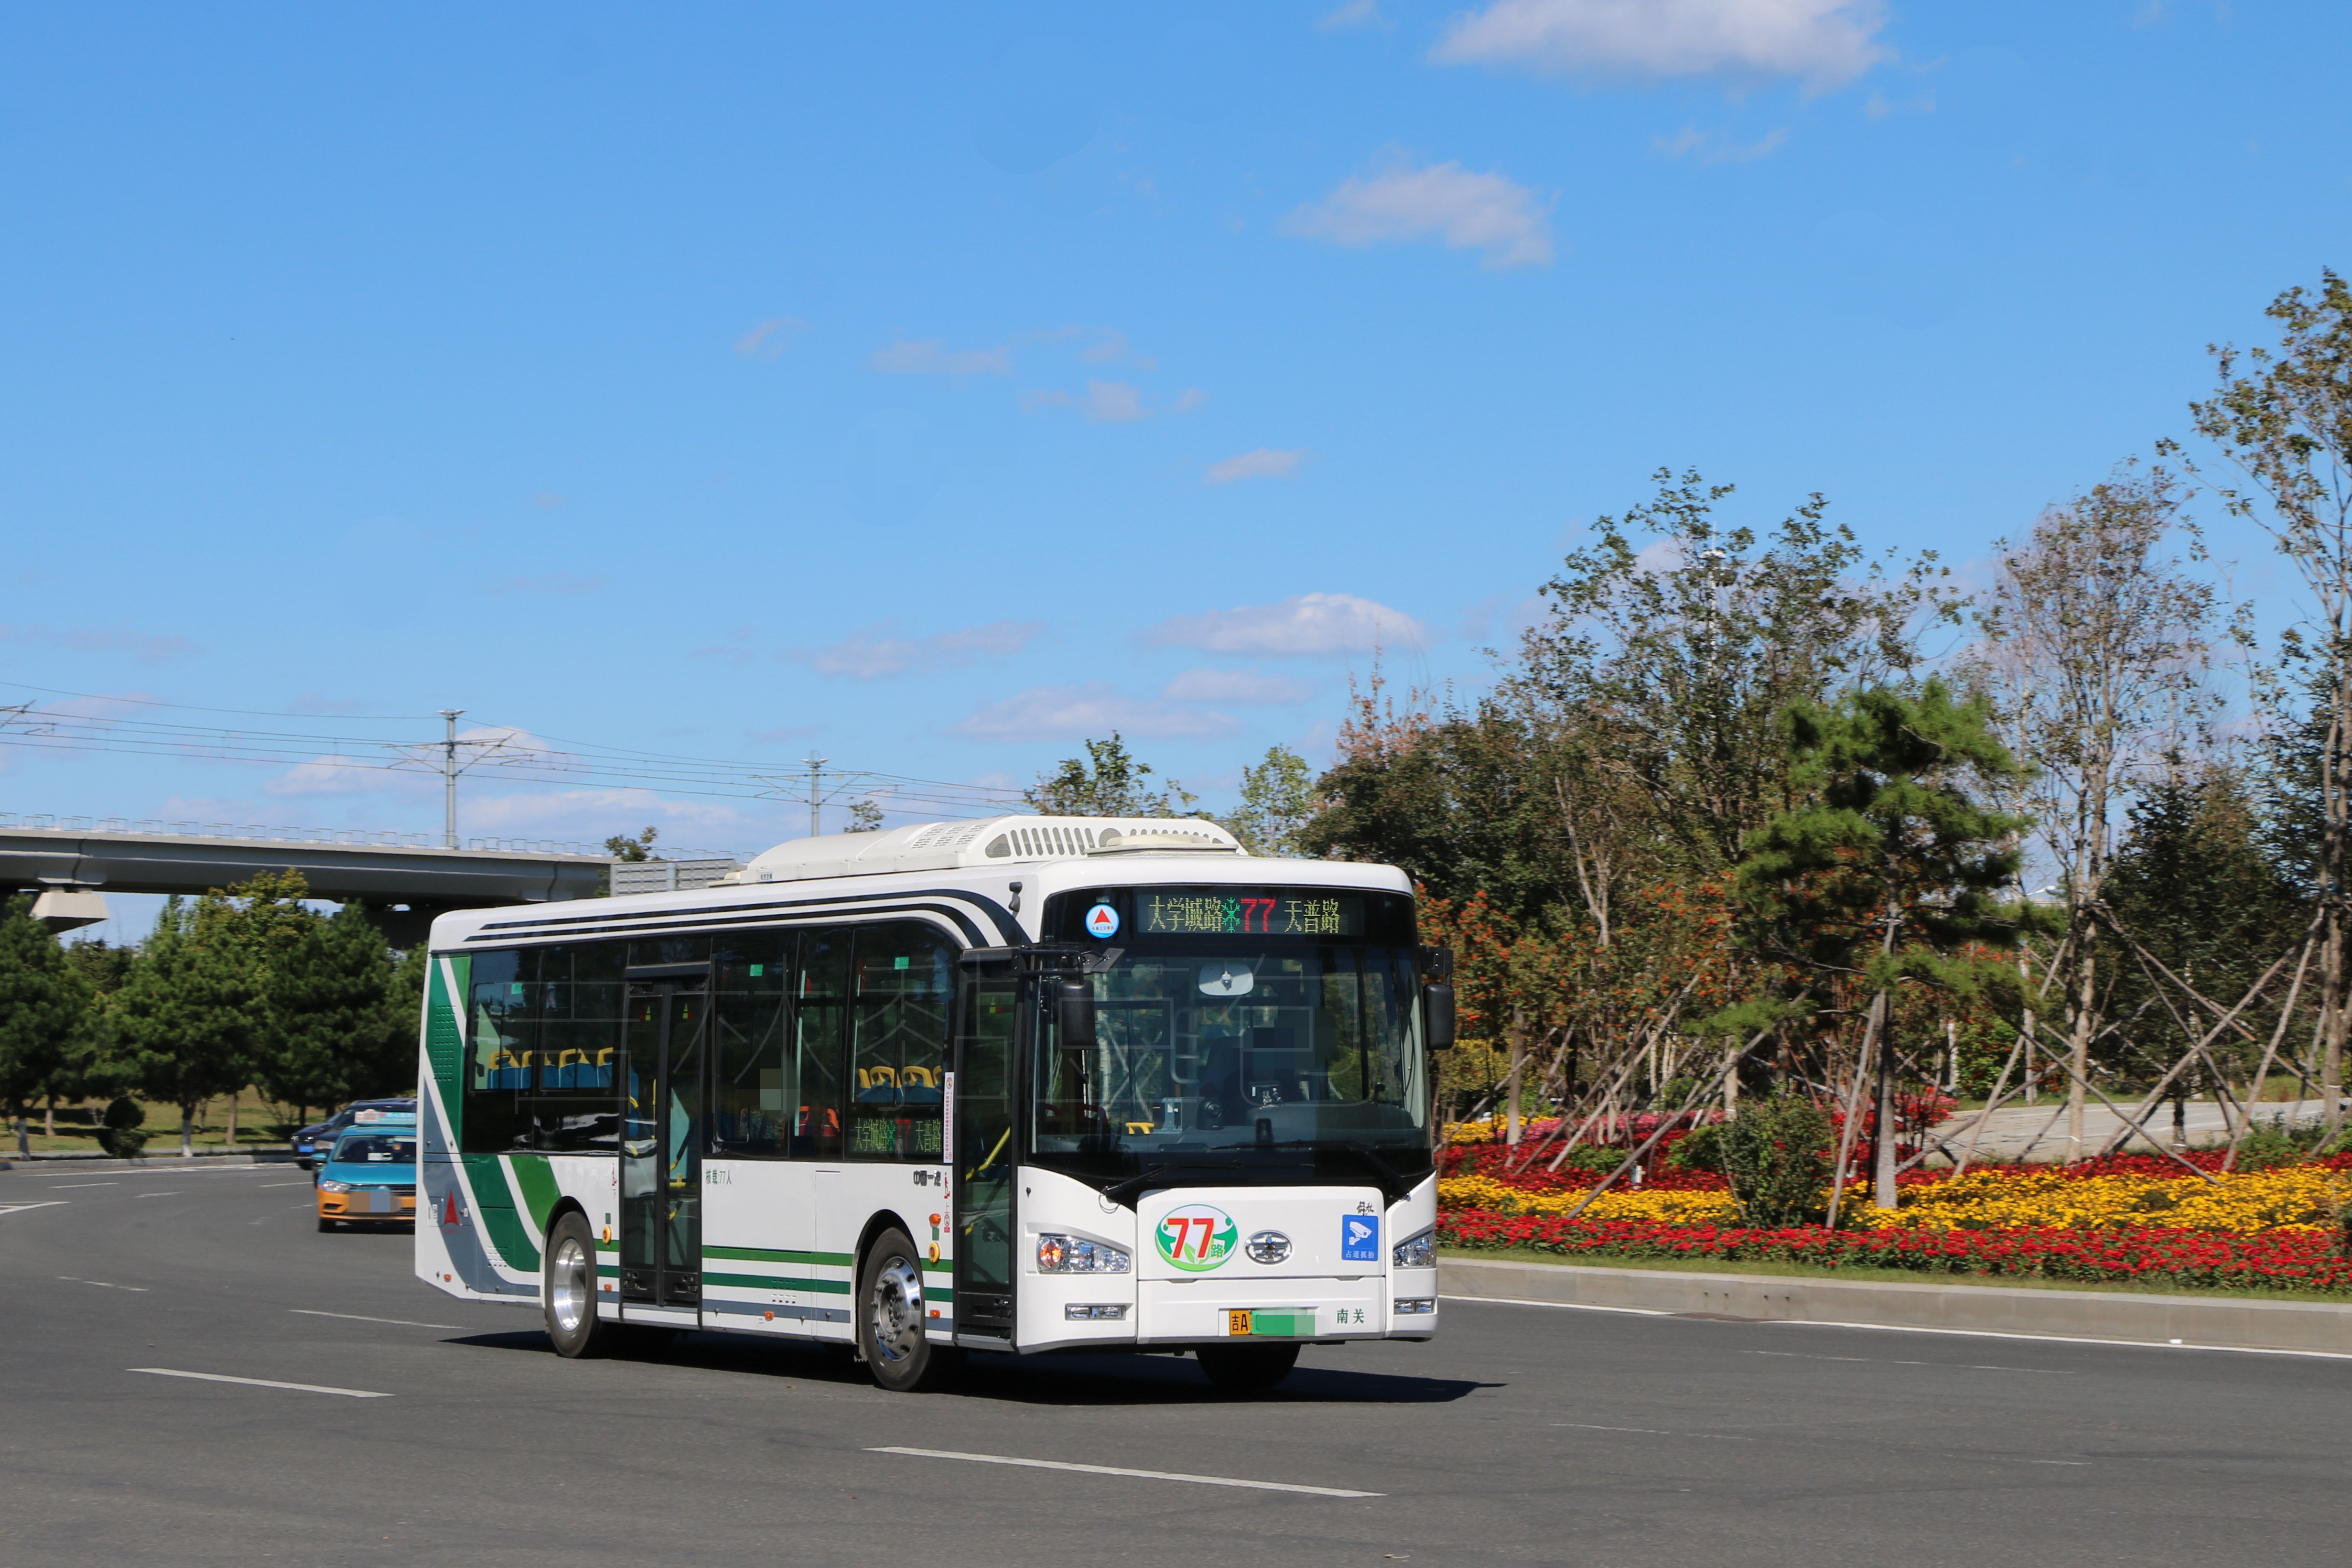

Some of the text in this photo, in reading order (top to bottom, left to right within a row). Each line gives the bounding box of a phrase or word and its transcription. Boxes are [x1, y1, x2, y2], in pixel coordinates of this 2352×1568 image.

[1147, 896, 1340, 933] 大学城路 77 天普路
[854, 1118, 887, 1152] 大学城路
[895, 1119, 912, 1152] 77
[915, 1118, 941, 1152] 天普路
[944, 1202, 950, 1213] 上
[1346, 1250, 1374, 1259] 占道抓拍
[1337, 1308, 1365, 1324] 南关
